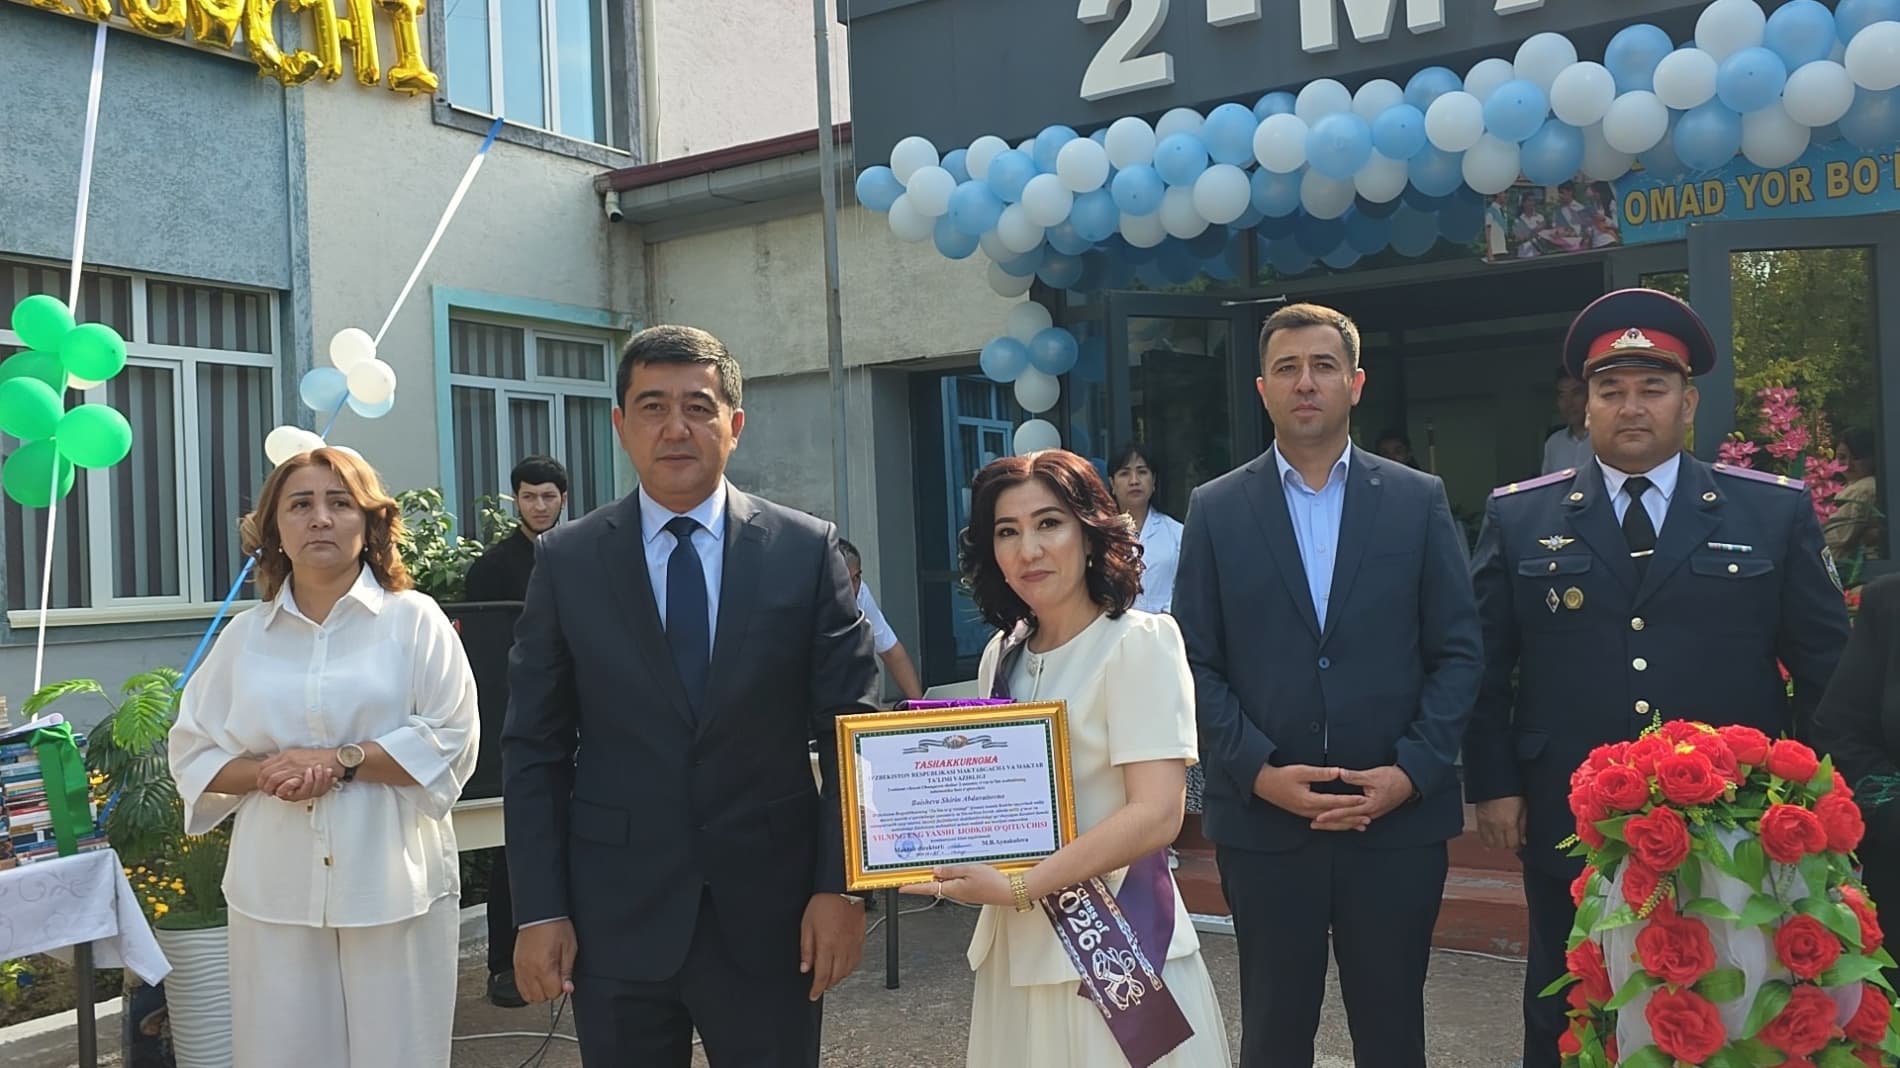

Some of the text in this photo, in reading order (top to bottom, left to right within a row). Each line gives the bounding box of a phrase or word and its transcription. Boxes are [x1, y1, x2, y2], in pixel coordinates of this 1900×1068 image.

[1624, 178, 1725, 226] OMAD
[1736, 166, 1814, 210] YOR
[914, 755, 998, 770] TASHAKKURNOMA
[1051, 886, 1102, 951] 026
[1095, 920, 1110, 933] of
